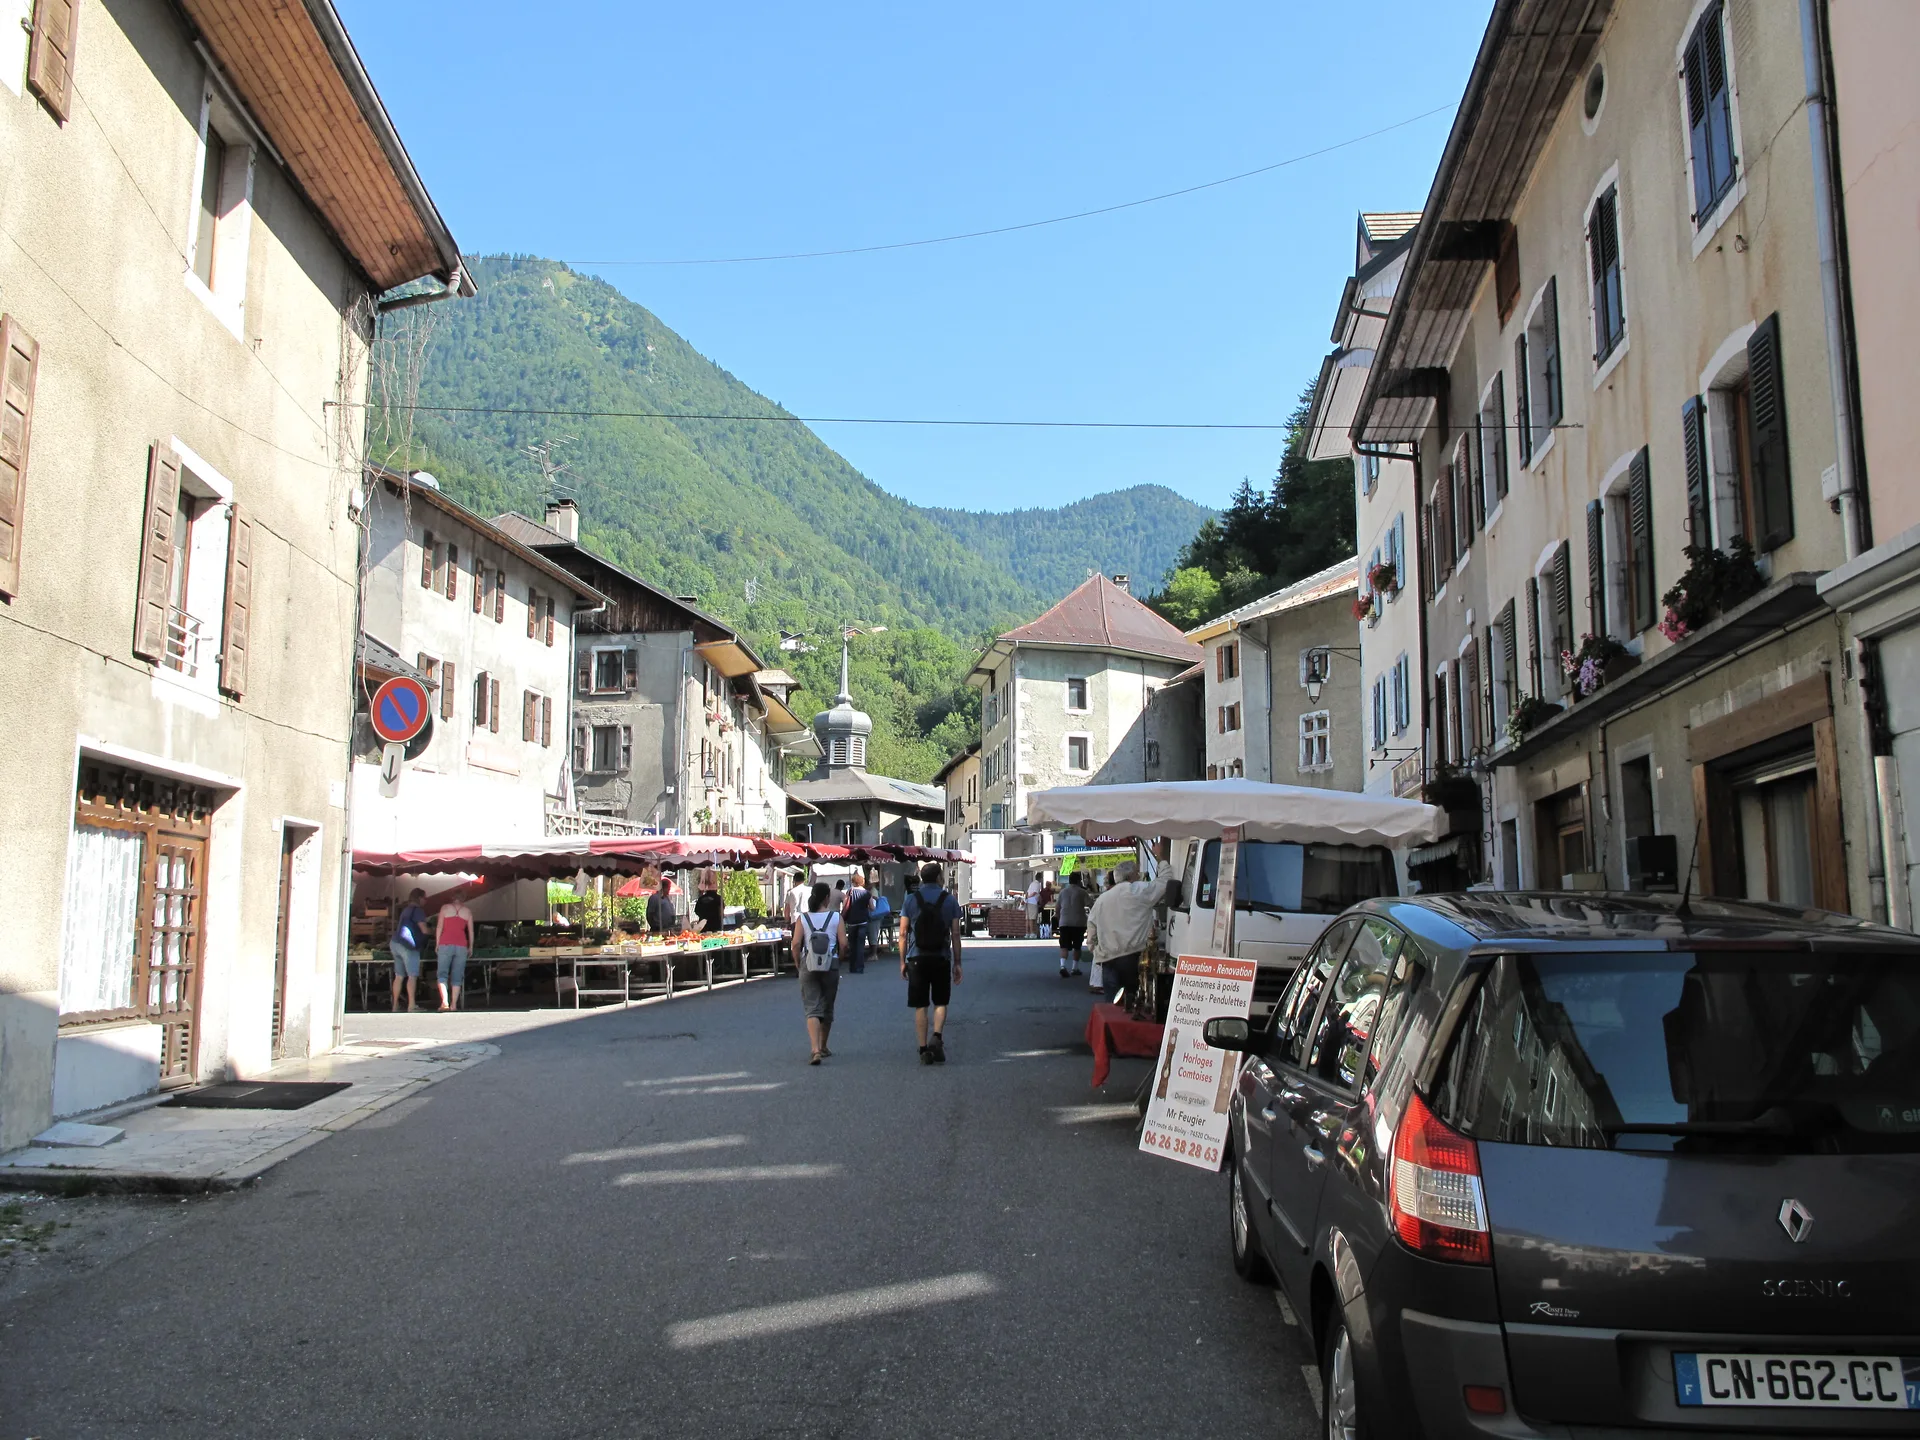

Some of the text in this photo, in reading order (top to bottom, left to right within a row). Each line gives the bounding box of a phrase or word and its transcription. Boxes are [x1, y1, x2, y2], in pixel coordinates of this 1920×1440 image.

[1180, 960, 1212, 973] Réparation
[1216, 963, 1253, 977] Rénovation
[1180, 977, 1240, 993] Mécanismes à poids
[1178, 990, 1204, 1002] Pendules
[1208, 994, 1247, 1008] Pendulettes
[1175, 1003, 1200, 1015] Carillons
[1183, 1052, 1213, 1068] Horloges
[1178, 1067, 1212, 1083] Comtoises
[1174, 1092, 1206, 1106] Devis gratuit
[1166, 1108, 1206, 1127] Mr Feugier
[1156, 1122, 1167, 1130] route
[1168, 1124, 1174, 1132] du
[1144, 1130, 1218, 1163] 06 26 38 28 63
[1763, 1279, 1852, 1298] SCENIC
[1706, 1357, 1898, 1402] CN-662-CC
[1685, 1384, 1693, 1396] F
[1906, 1384, 1920, 1405] 7
